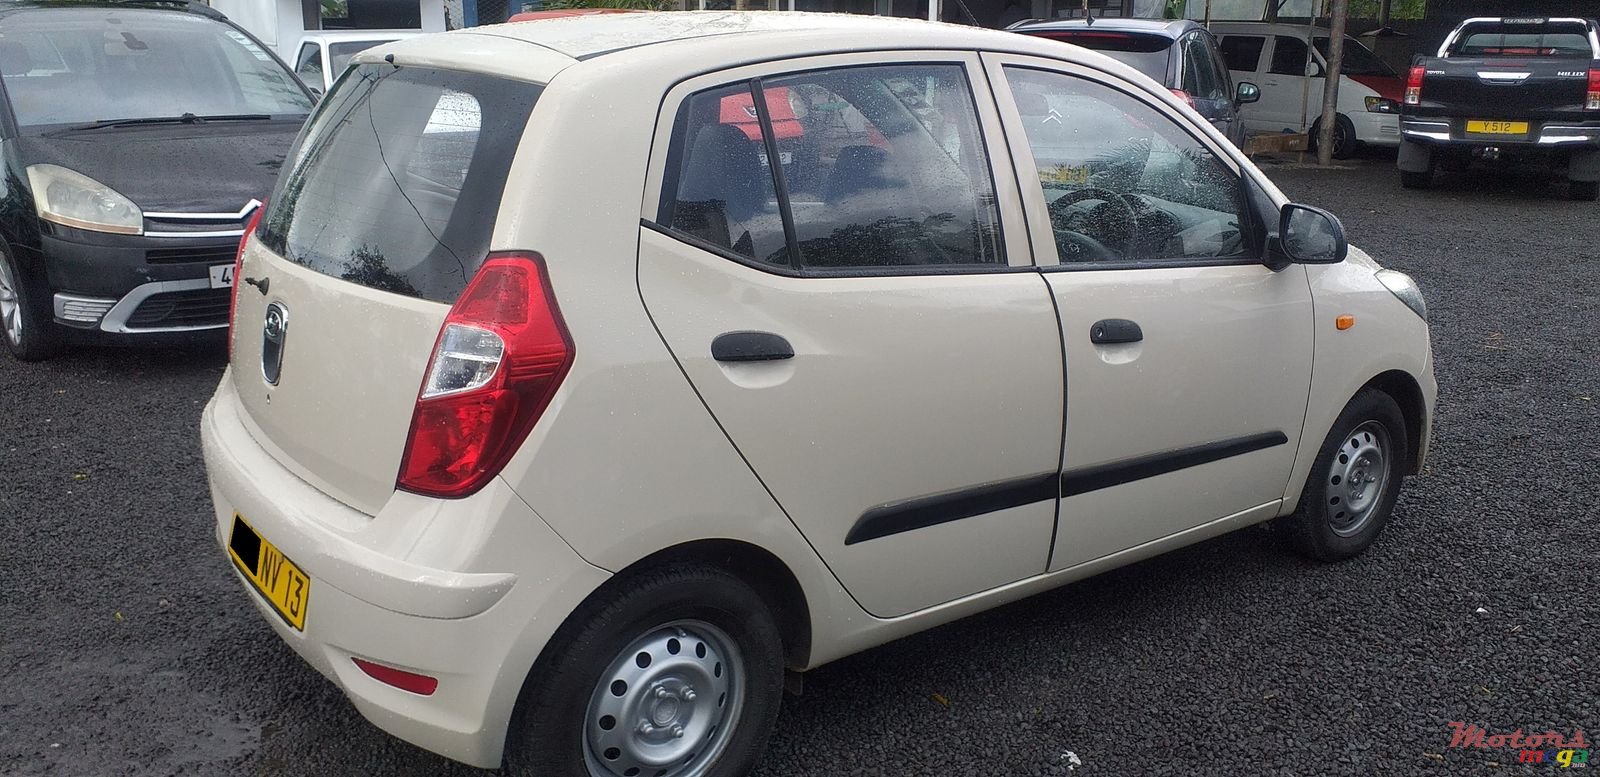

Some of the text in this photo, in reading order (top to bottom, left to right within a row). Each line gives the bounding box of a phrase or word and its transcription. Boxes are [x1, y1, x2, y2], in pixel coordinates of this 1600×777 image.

[1483, 122, 1511, 132] Y 512
[260, 545, 304, 618] NV 13
